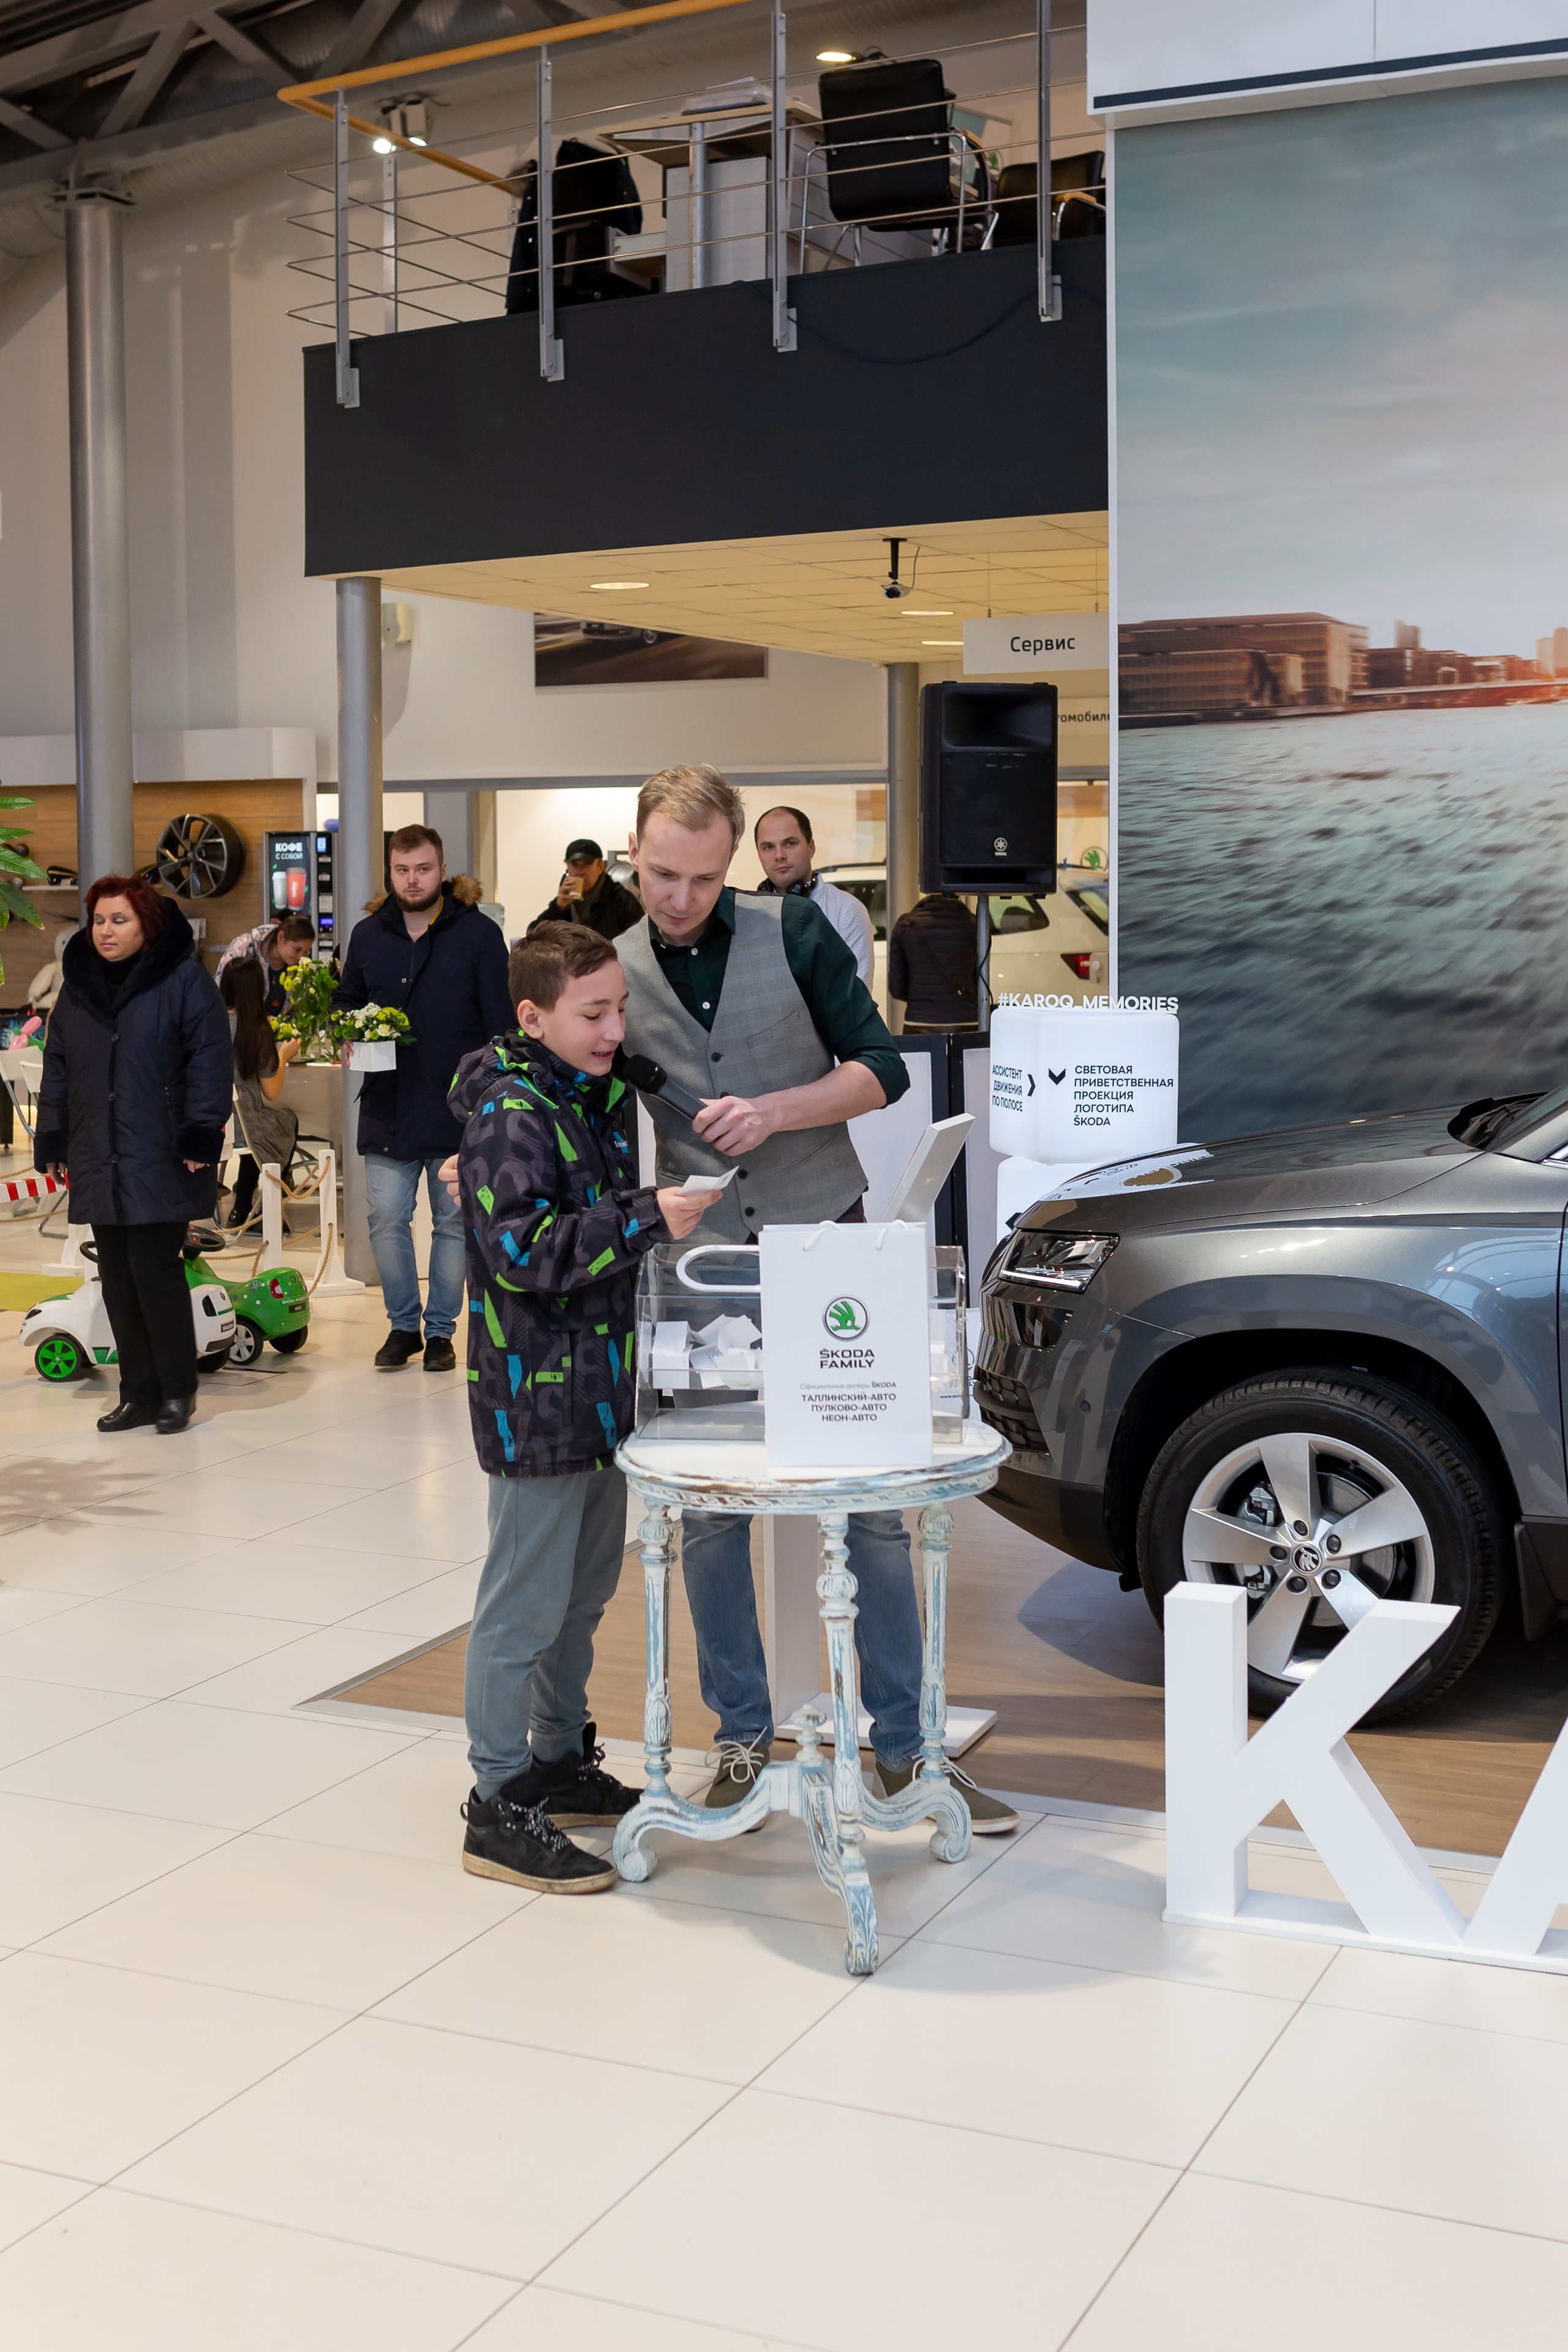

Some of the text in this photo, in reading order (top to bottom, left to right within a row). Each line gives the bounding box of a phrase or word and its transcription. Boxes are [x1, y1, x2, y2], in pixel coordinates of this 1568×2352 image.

[1010, 636, 1076, 655] Сервис
[1058, 710, 1109, 723] омобил
[275, 842, 303, 852] КОФЕ
[998, 993, 1179, 1012] #KAROQ_MEMORIES
[992, 1064, 1022, 1080] АССИСТЕНТ
[1075, 1065, 1133, 1074] СВЕТОВАЯ
[993, 1080, 1023, 1096] ДВИЖЕНИЯ
[1074, 1078, 1174, 1088] ПРИВЕТСТВЕННАЯ
[1074, 1091, 1134, 1101] ПРОЕКЦИЯ
[992, 1095, 1023, 1112] ПО ПОЛОСЕ
[1074, 1104, 1134, 1113] ЛОГОТИПА
[1074, 1115, 1110, 1126] ŠKODA
[820, 1348, 875, 1359] ŠKODA
[820, 1359, 875, 1369] FAMILY
[801, 1392, 897, 1402] ТАЛЛИНСКИЙ-АВТО
[812, 1403, 887, 1412] ПУЛКОВО-АВТО
[822, 1414, 877, 1422] НЕОН-АВТО
